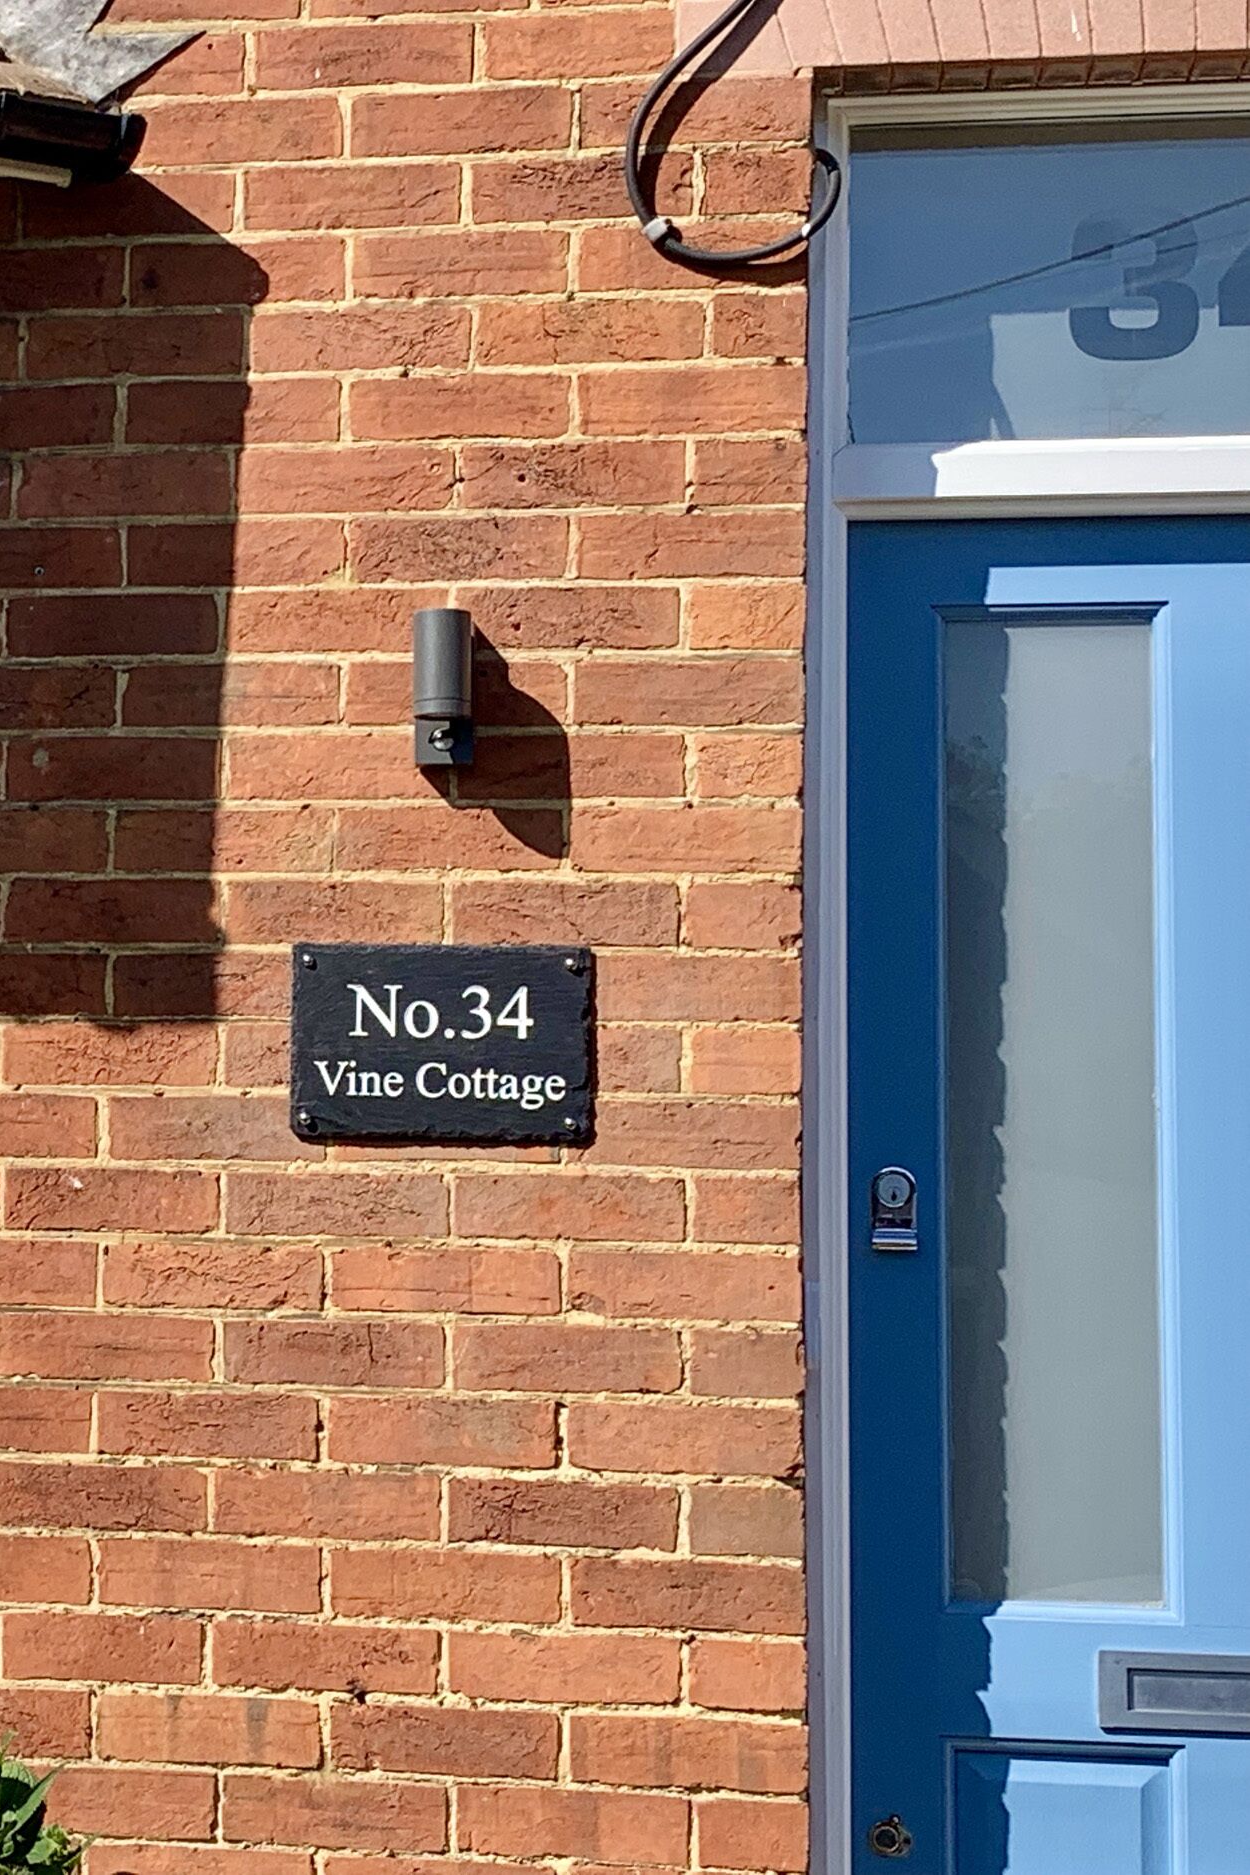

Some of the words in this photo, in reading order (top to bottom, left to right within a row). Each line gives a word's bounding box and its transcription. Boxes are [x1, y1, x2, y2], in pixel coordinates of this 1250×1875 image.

[1069, 210, 1250, 360] 3
[347, 984, 534, 1040] No.34
[314, 1060, 404, 1098] Vine
[416, 1062, 566, 1110] Cottage
